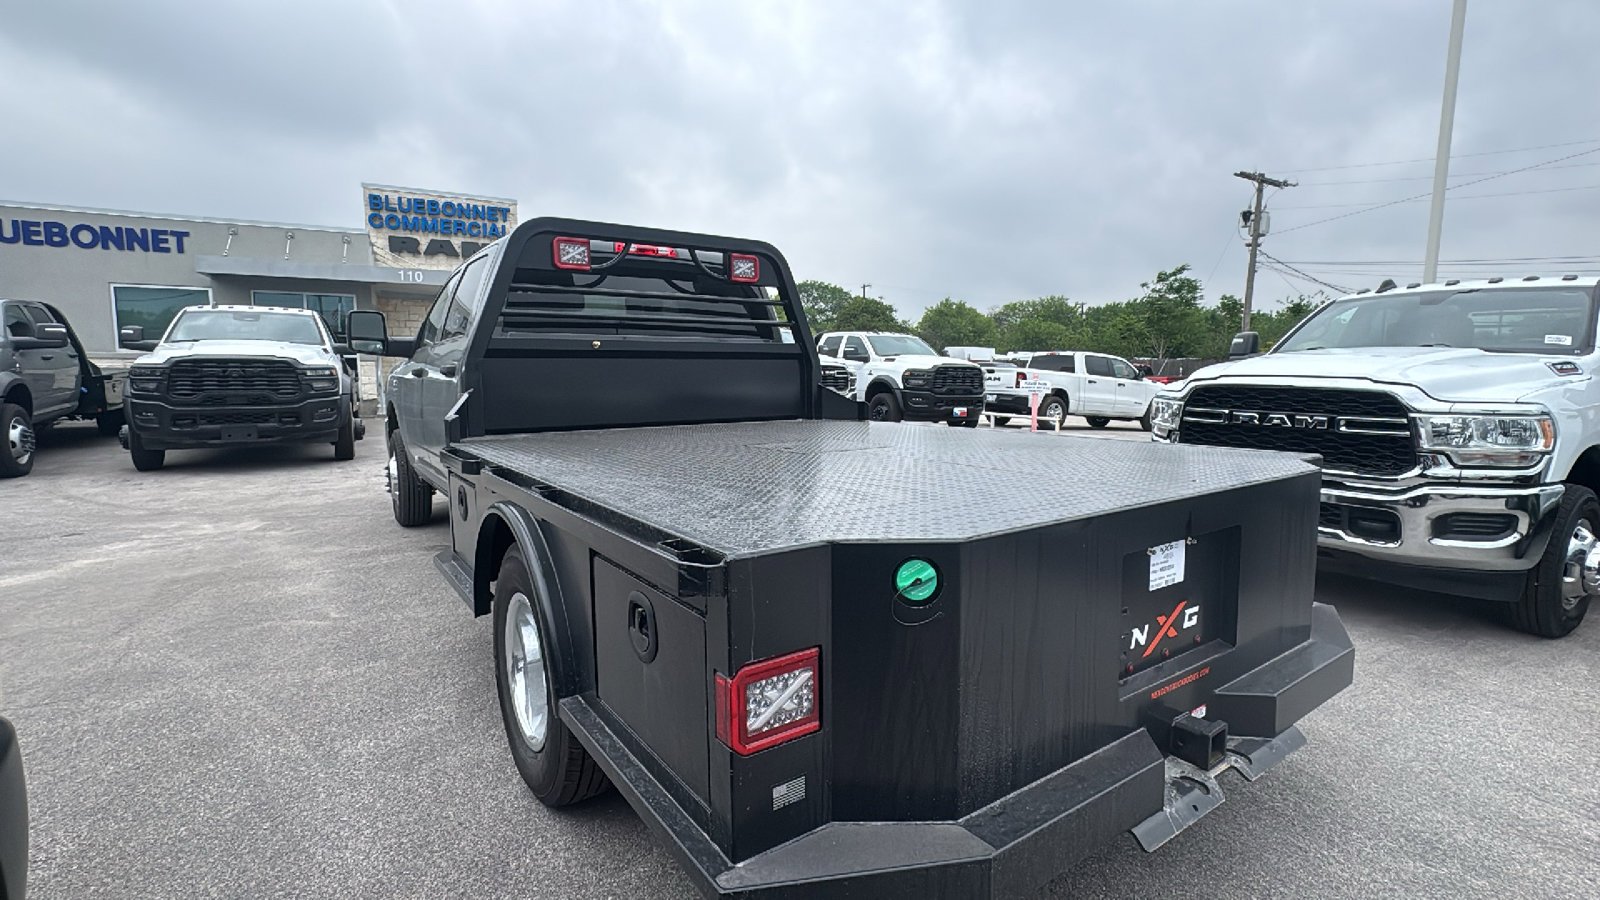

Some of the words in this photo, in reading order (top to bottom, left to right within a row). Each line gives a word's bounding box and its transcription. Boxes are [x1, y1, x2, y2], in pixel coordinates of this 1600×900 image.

[368, 193, 510, 222] BLUEBONNET
[398, 270, 423, 282] 110
[1232, 411, 1328, 429] RAM
[1129, 600, 1200, 659] NXG
